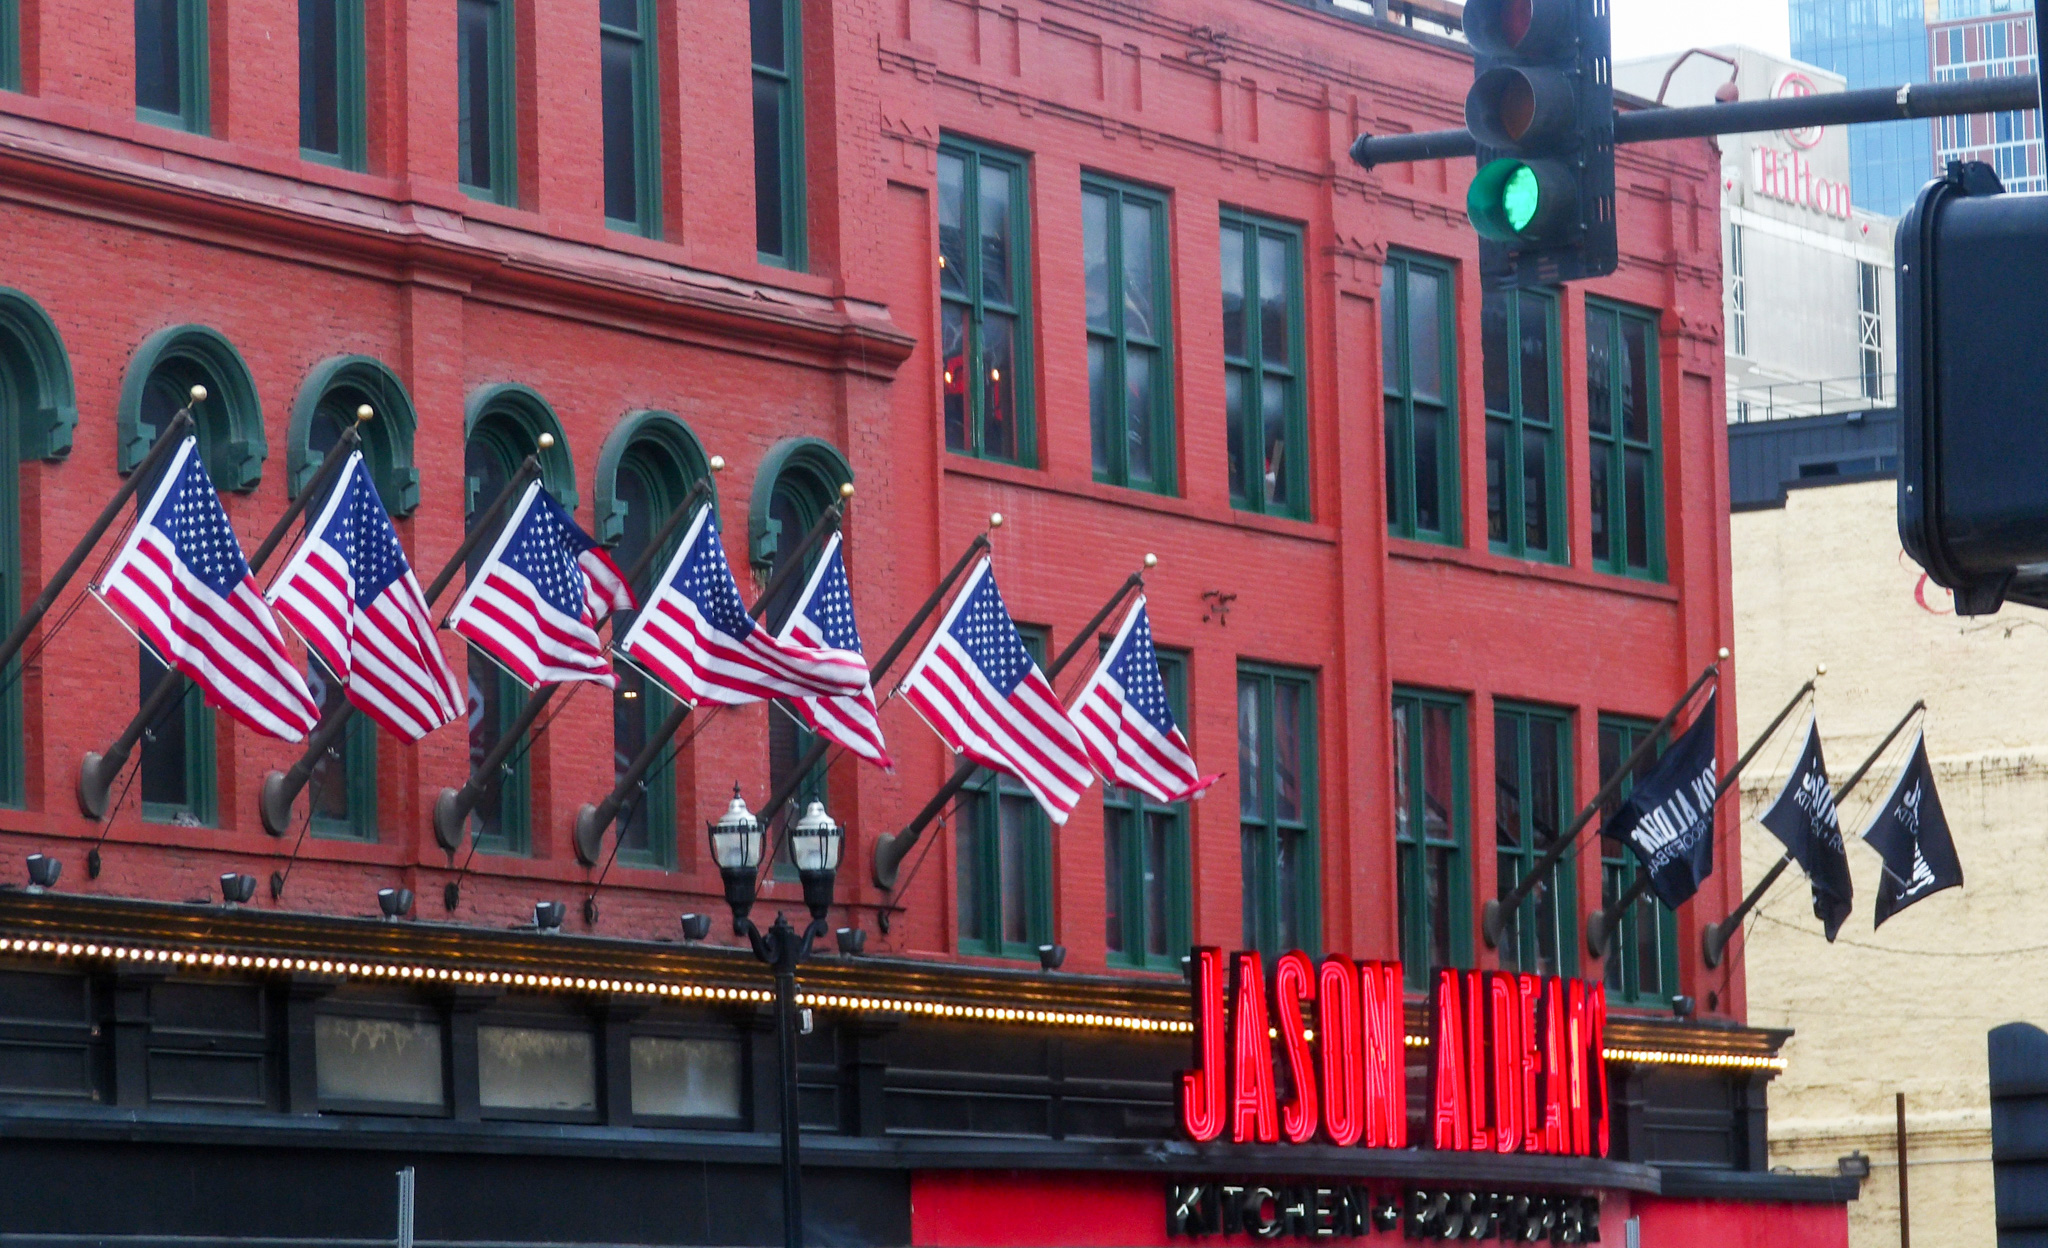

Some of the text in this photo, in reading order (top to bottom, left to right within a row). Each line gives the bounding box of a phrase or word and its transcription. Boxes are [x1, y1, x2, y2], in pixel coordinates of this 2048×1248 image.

[1758, 146, 1851, 218] Hilton
[1178, 946, 1407, 1149] JASON
[1167, 1184, 1370, 1237] KITCHEN
